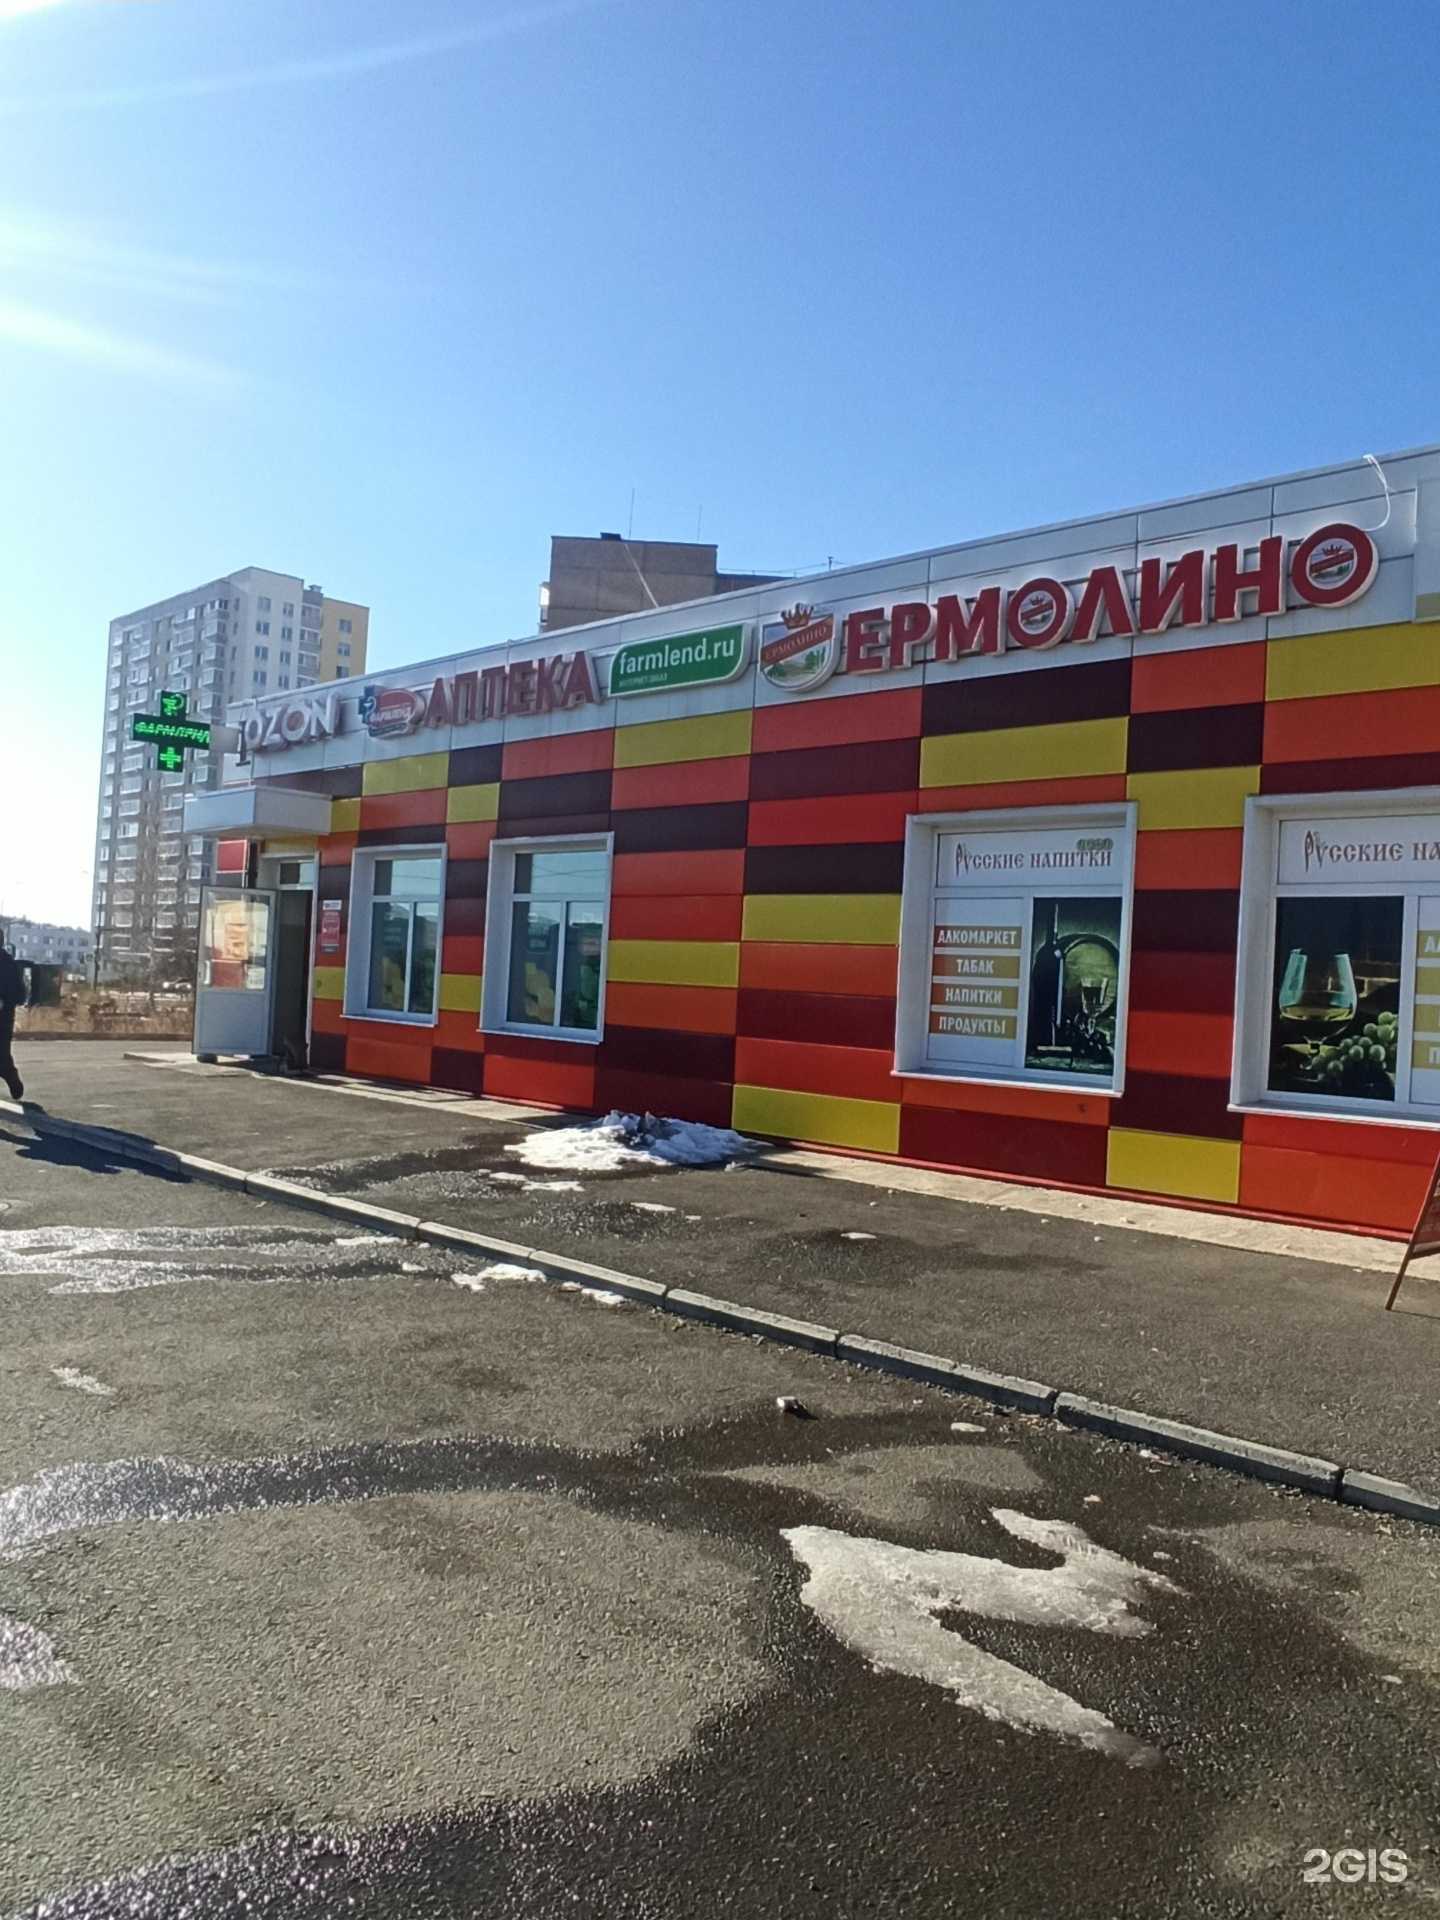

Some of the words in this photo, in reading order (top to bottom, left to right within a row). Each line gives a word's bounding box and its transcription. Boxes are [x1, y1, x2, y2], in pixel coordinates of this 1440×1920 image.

[846, 523, 1373, 673] ЕРМОЛИНО
[619, 637, 735, 675] farmlend.ru
[423, 651, 595, 727] АПТЕКА
[1304, 830, 1402, 872] Русские
[937, 929, 1017, 945] АЛКОМАРКЕТ
[956, 959, 994, 974] ТАБАК
[945, 987, 1002, 1004] НАПИТКИ
[938, 1016, 1006, 1035] ПРОДУКТЫ
